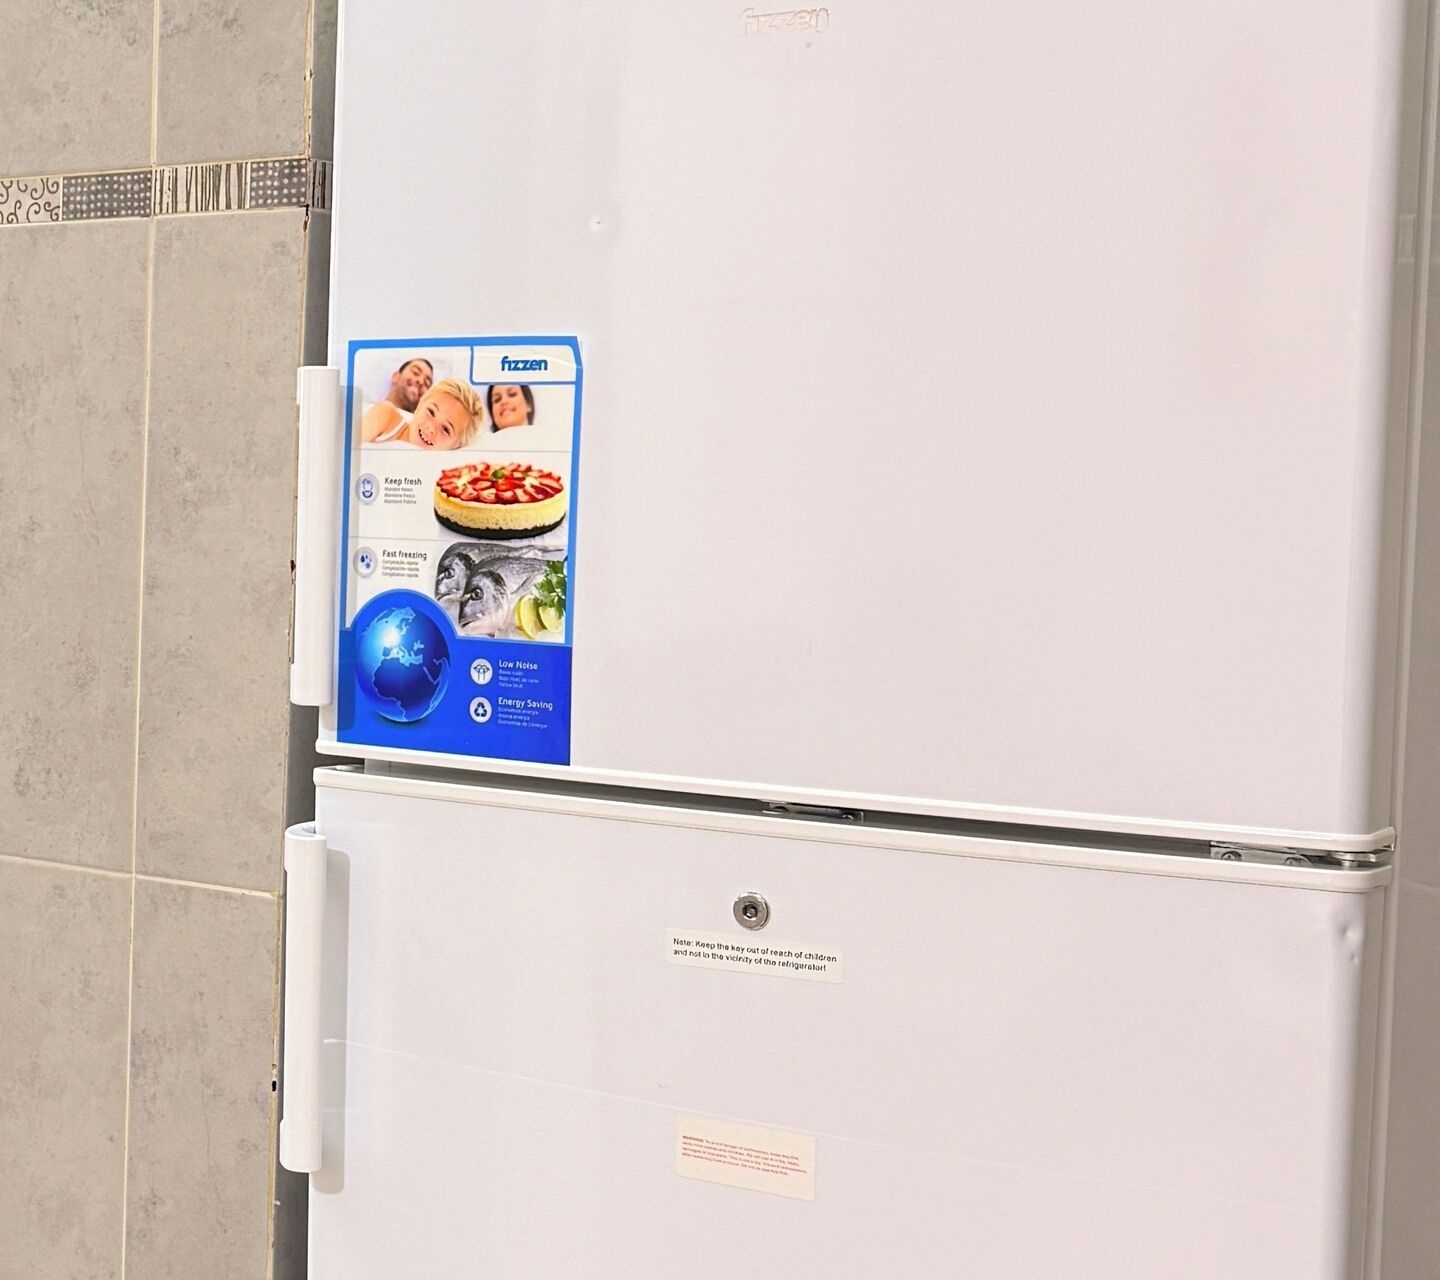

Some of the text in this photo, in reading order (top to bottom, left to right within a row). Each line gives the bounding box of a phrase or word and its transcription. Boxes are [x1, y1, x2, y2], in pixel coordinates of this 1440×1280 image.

[501, 355, 548, 371] fizzen
[384, 477, 422, 486] Keep fresh
[382, 549, 427, 560] Fast freezing
[499, 659, 538, 670] Low Noise
[498, 697, 525, 709] Energy
[527, 699, 553, 711] Saving
[689, 950, 701, 958] not
[711, 952, 724, 960] the
[726, 954, 753, 964] vicinity
[764, 958, 776, 966] the
[695, 940, 715, 950] Keep
[717, 943, 729, 951] the
[731, 944, 745, 953] key
[770, 950, 793, 958] reach
[804, 953, 837, 962] children
